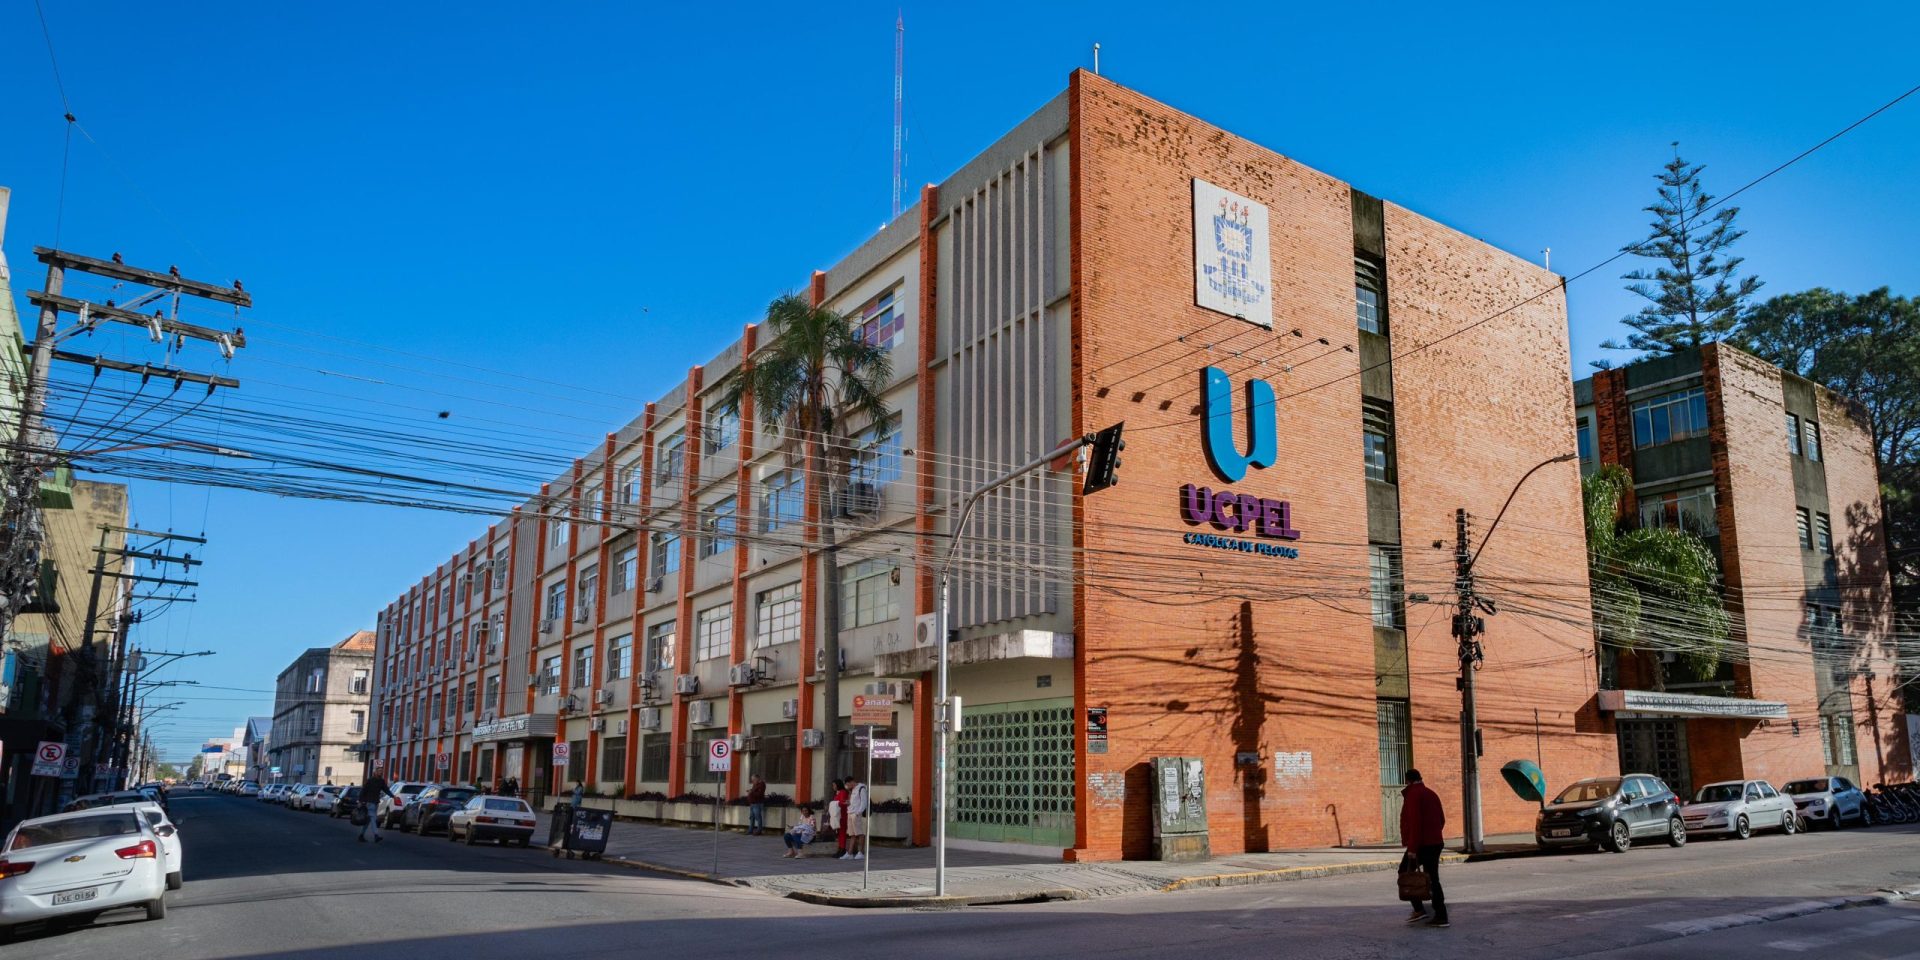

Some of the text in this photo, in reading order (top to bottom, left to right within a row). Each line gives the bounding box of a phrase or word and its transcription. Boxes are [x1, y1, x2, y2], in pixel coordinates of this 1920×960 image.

[1181, 483, 1300, 540] UCPEL
[1257, 543, 1299, 558] PELOTAS
[716, 745, 724, 755] E
[75, 891, 96, 901] 0154
